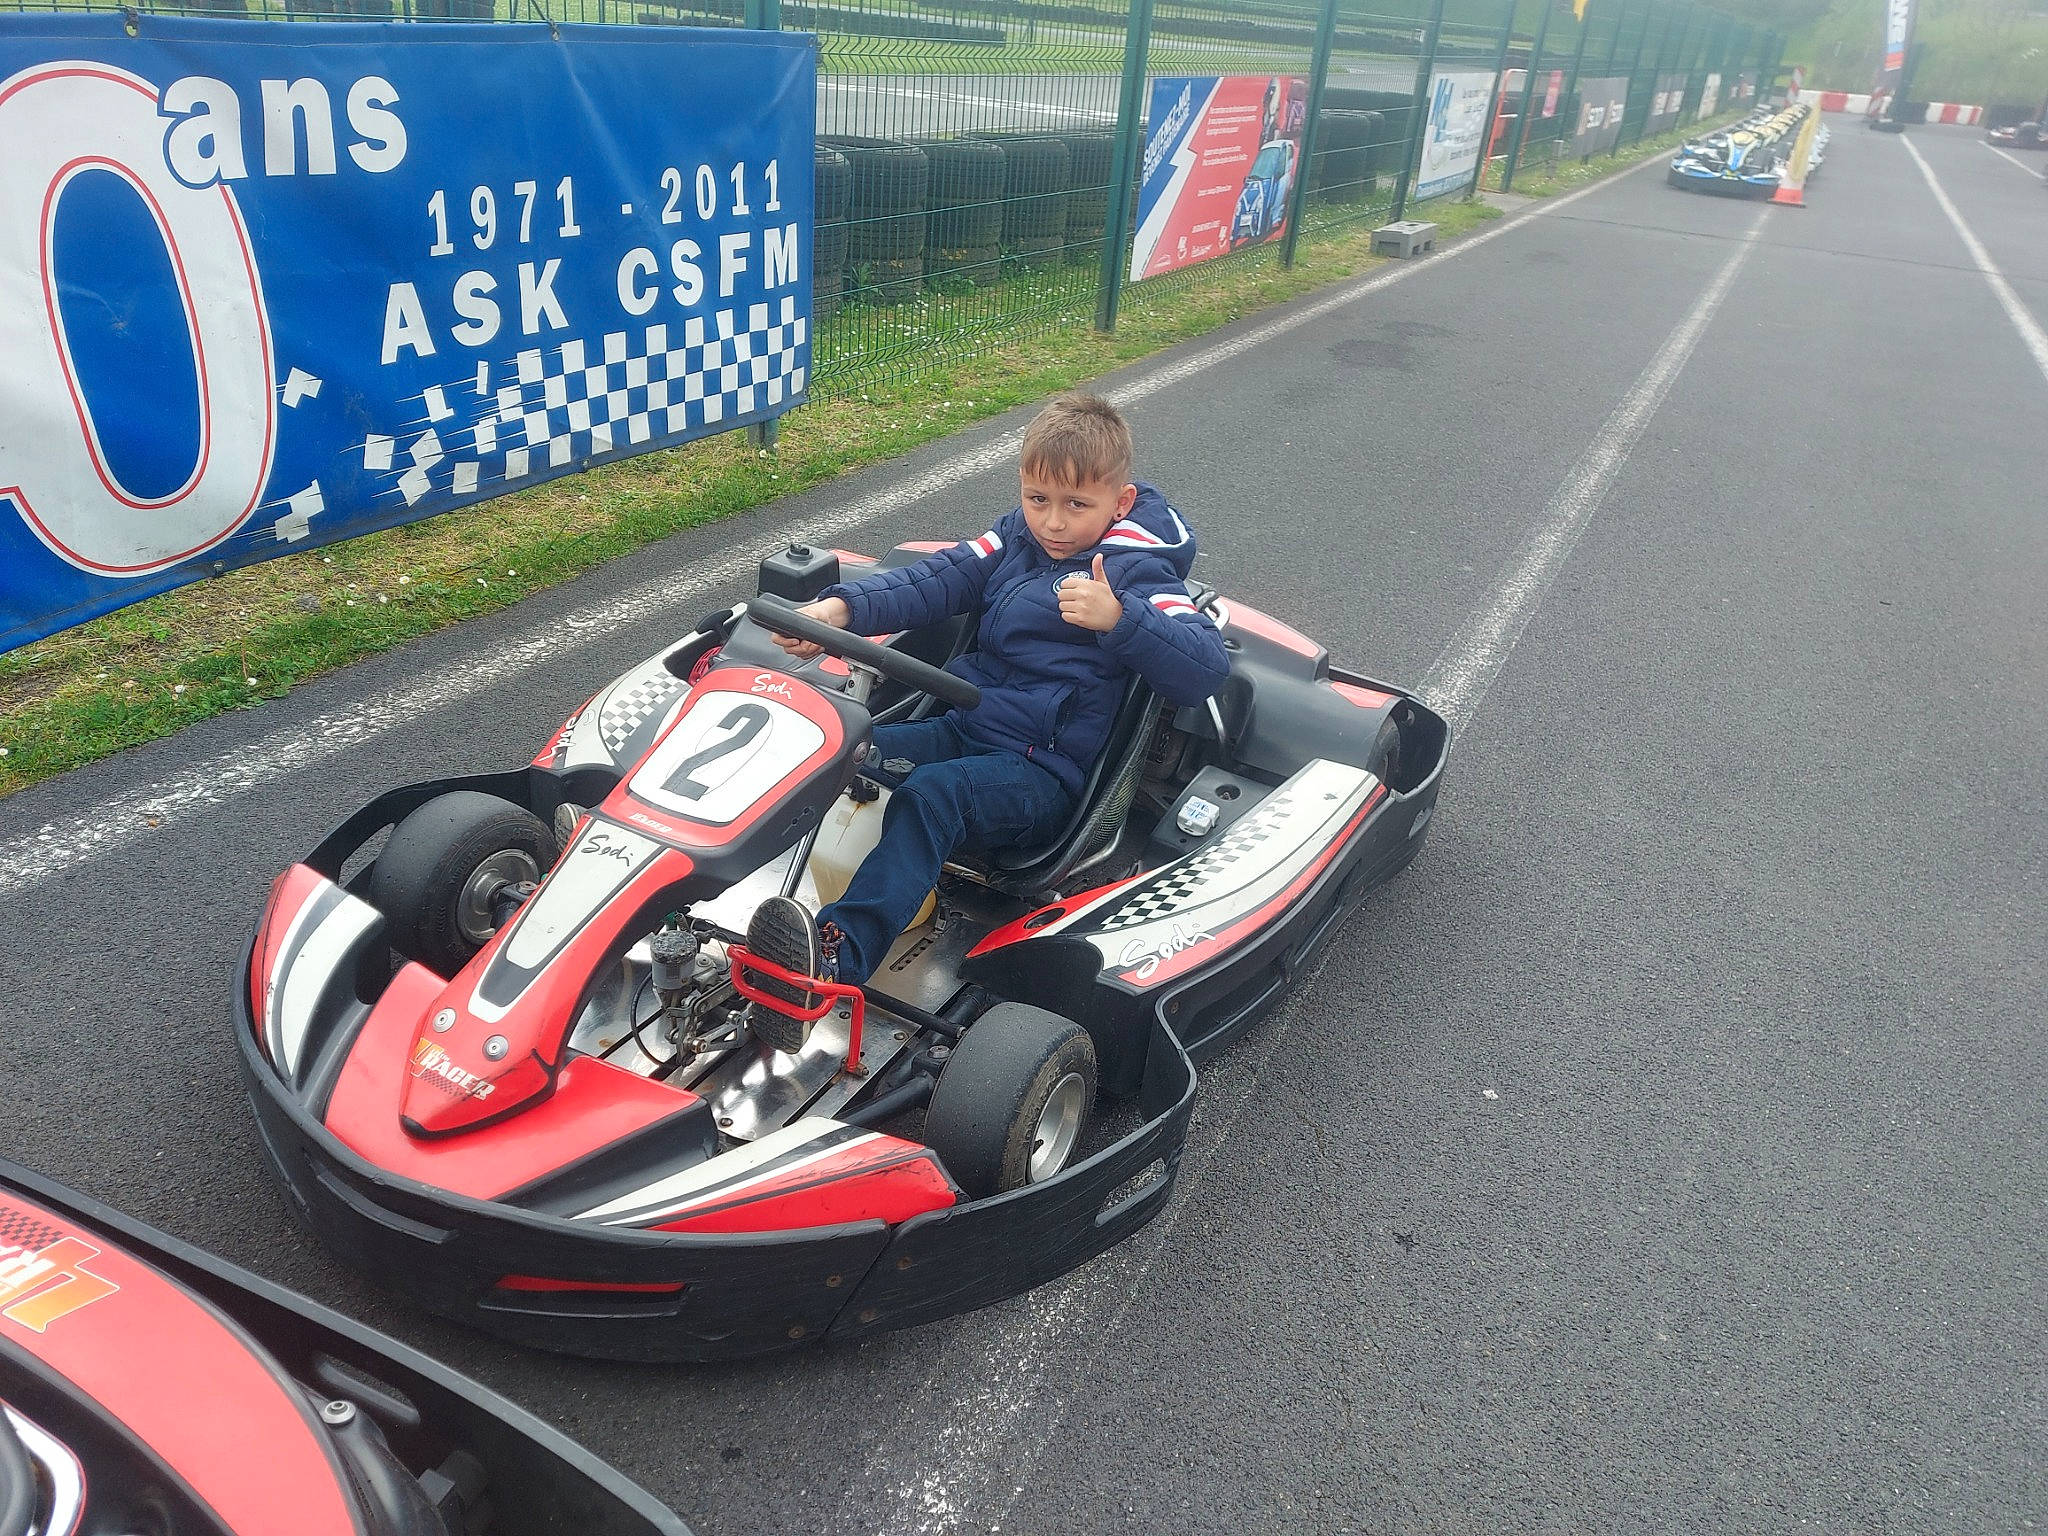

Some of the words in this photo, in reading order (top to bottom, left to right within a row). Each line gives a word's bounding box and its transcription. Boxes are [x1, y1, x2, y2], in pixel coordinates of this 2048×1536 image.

[427, 175, 581, 257] 1971
[660, 159, 781, 225] 2011
[0, 61, 274, 578] 0
[163, 75, 407, 186] ans
[380, 258, 570, 366] ASK
[616, 222, 799, 316] CSFM
[751, 672, 793, 700] Sodi
[660, 703, 770, 802] 2
[580, 834, 634, 867] Sodi
[1118, 924, 1217, 980] Sodi
